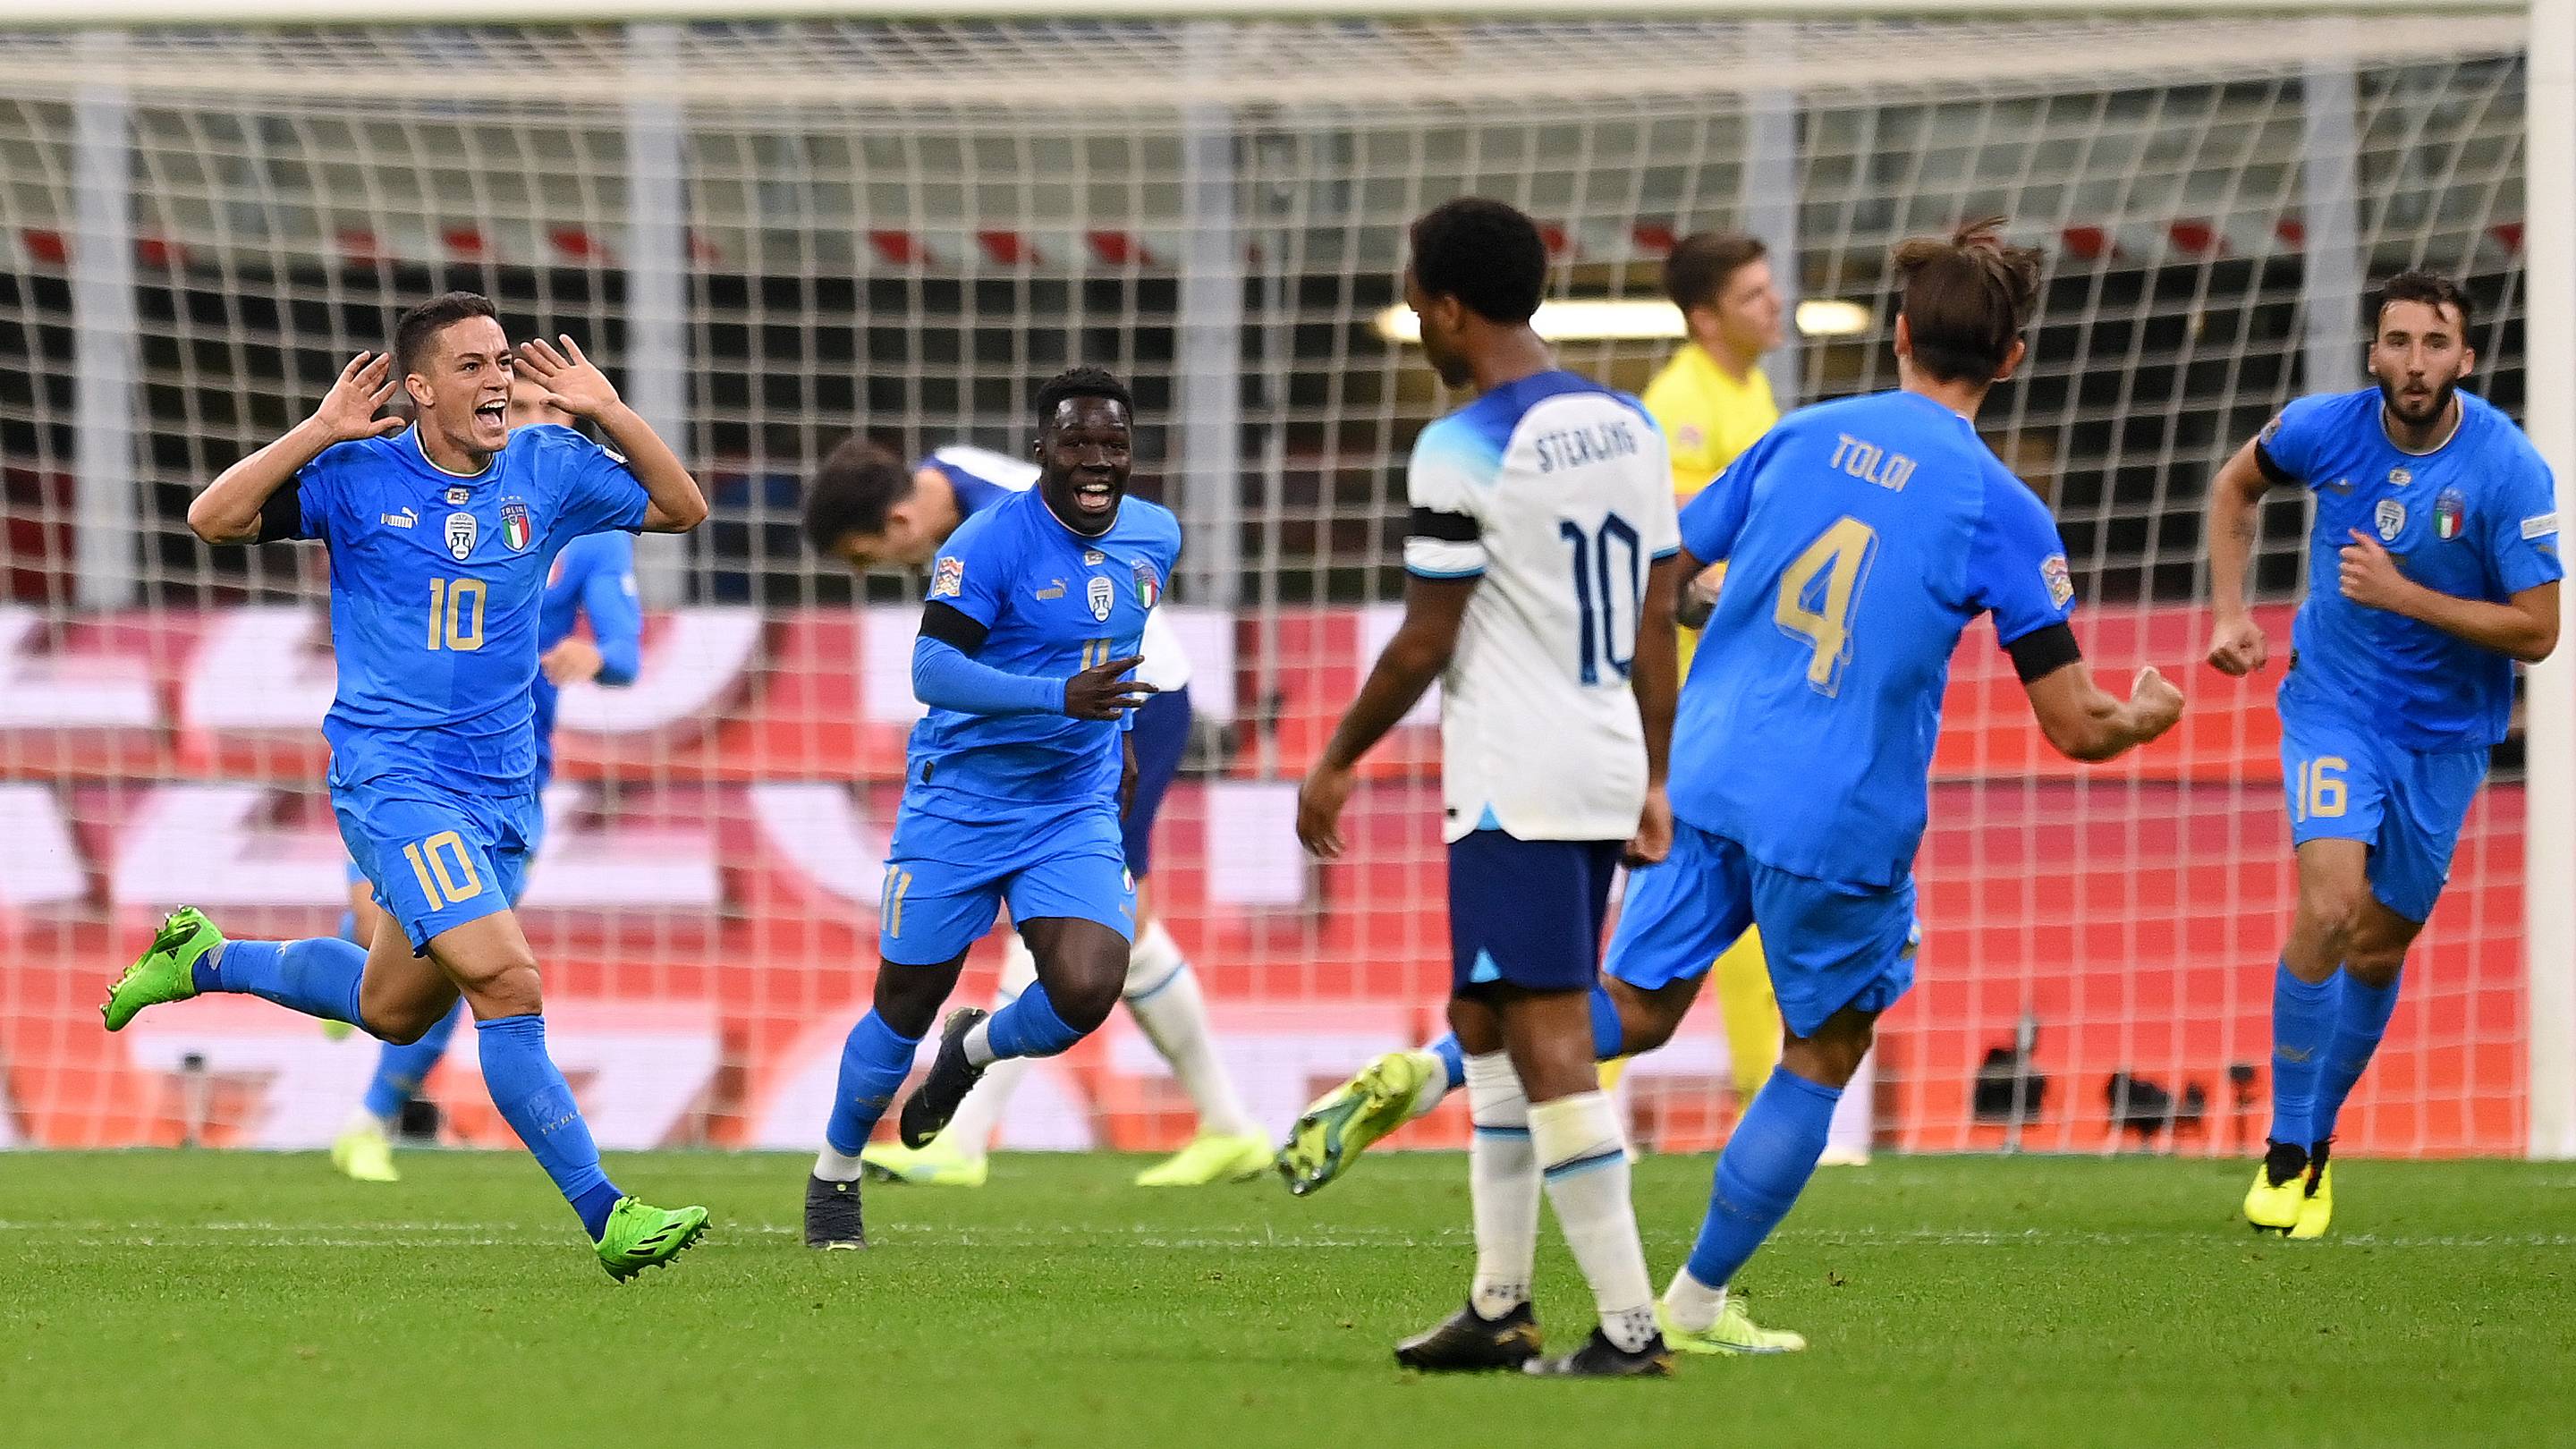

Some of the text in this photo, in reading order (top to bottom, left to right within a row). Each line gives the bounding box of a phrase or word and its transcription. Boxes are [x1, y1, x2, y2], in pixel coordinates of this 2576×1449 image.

[1830, 433, 1918, 492] TOLOI
[428, 577, 487, 651] 10
[1559, 511, 1640, 686] 10
[1774, 514, 1879, 698] 4
[2296, 756, 2348, 824] 16
[402, 830, 483, 912] 10
[880, 864, 912, 939] 11
